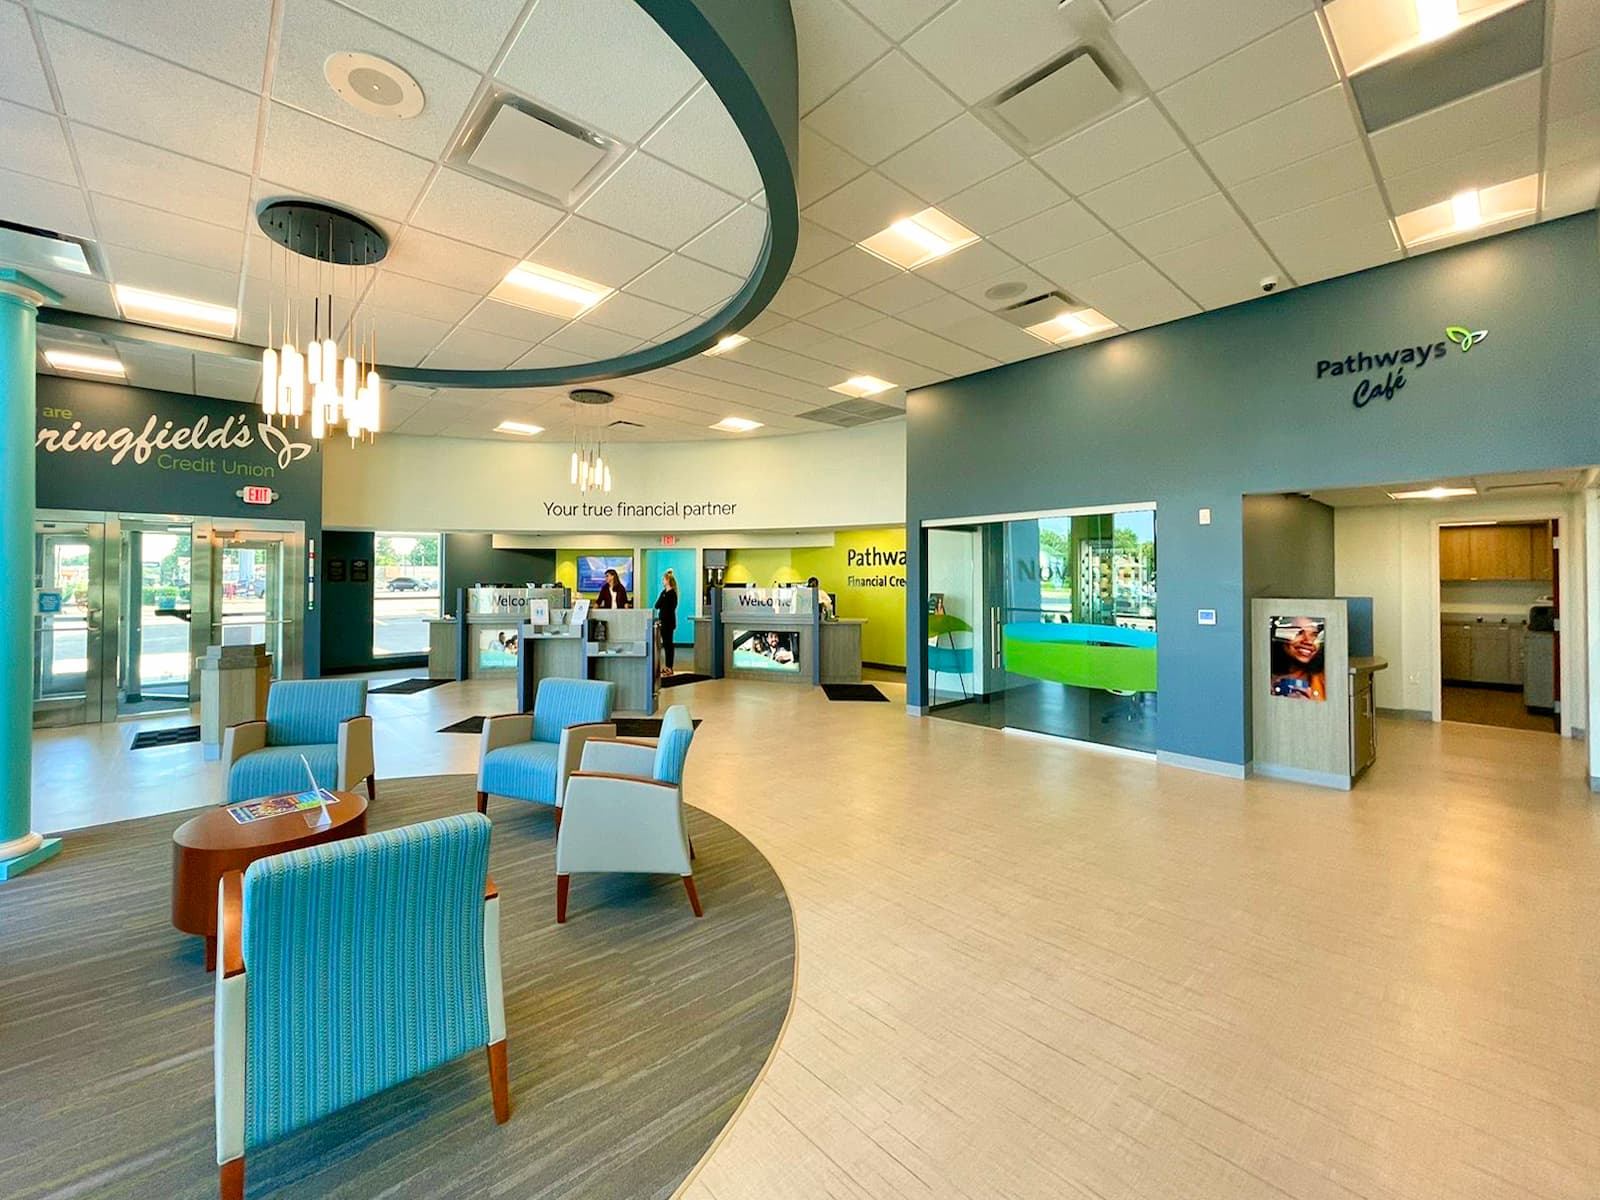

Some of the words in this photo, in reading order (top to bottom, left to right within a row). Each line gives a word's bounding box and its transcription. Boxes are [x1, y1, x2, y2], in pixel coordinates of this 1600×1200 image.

[1316, 340, 1448, 380] Pathways
[1352, 366, 1407, 408] Café
[42, 407, 73, 420] are
[35, 413, 255, 466] ringfield's
[157, 453, 217, 473] Credit
[222, 459, 275, 478] Union
[248, 487, 269, 502] EXIT
[543, 501, 578, 517] Your
[582, 502, 614, 517] true
[616, 501, 680, 517] financial
[683, 501, 737, 520] partner
[847, 546, 907, 567] Pathwa
[847, 575, 887, 588] Financial
[889, 575, 907, 588] Cre
